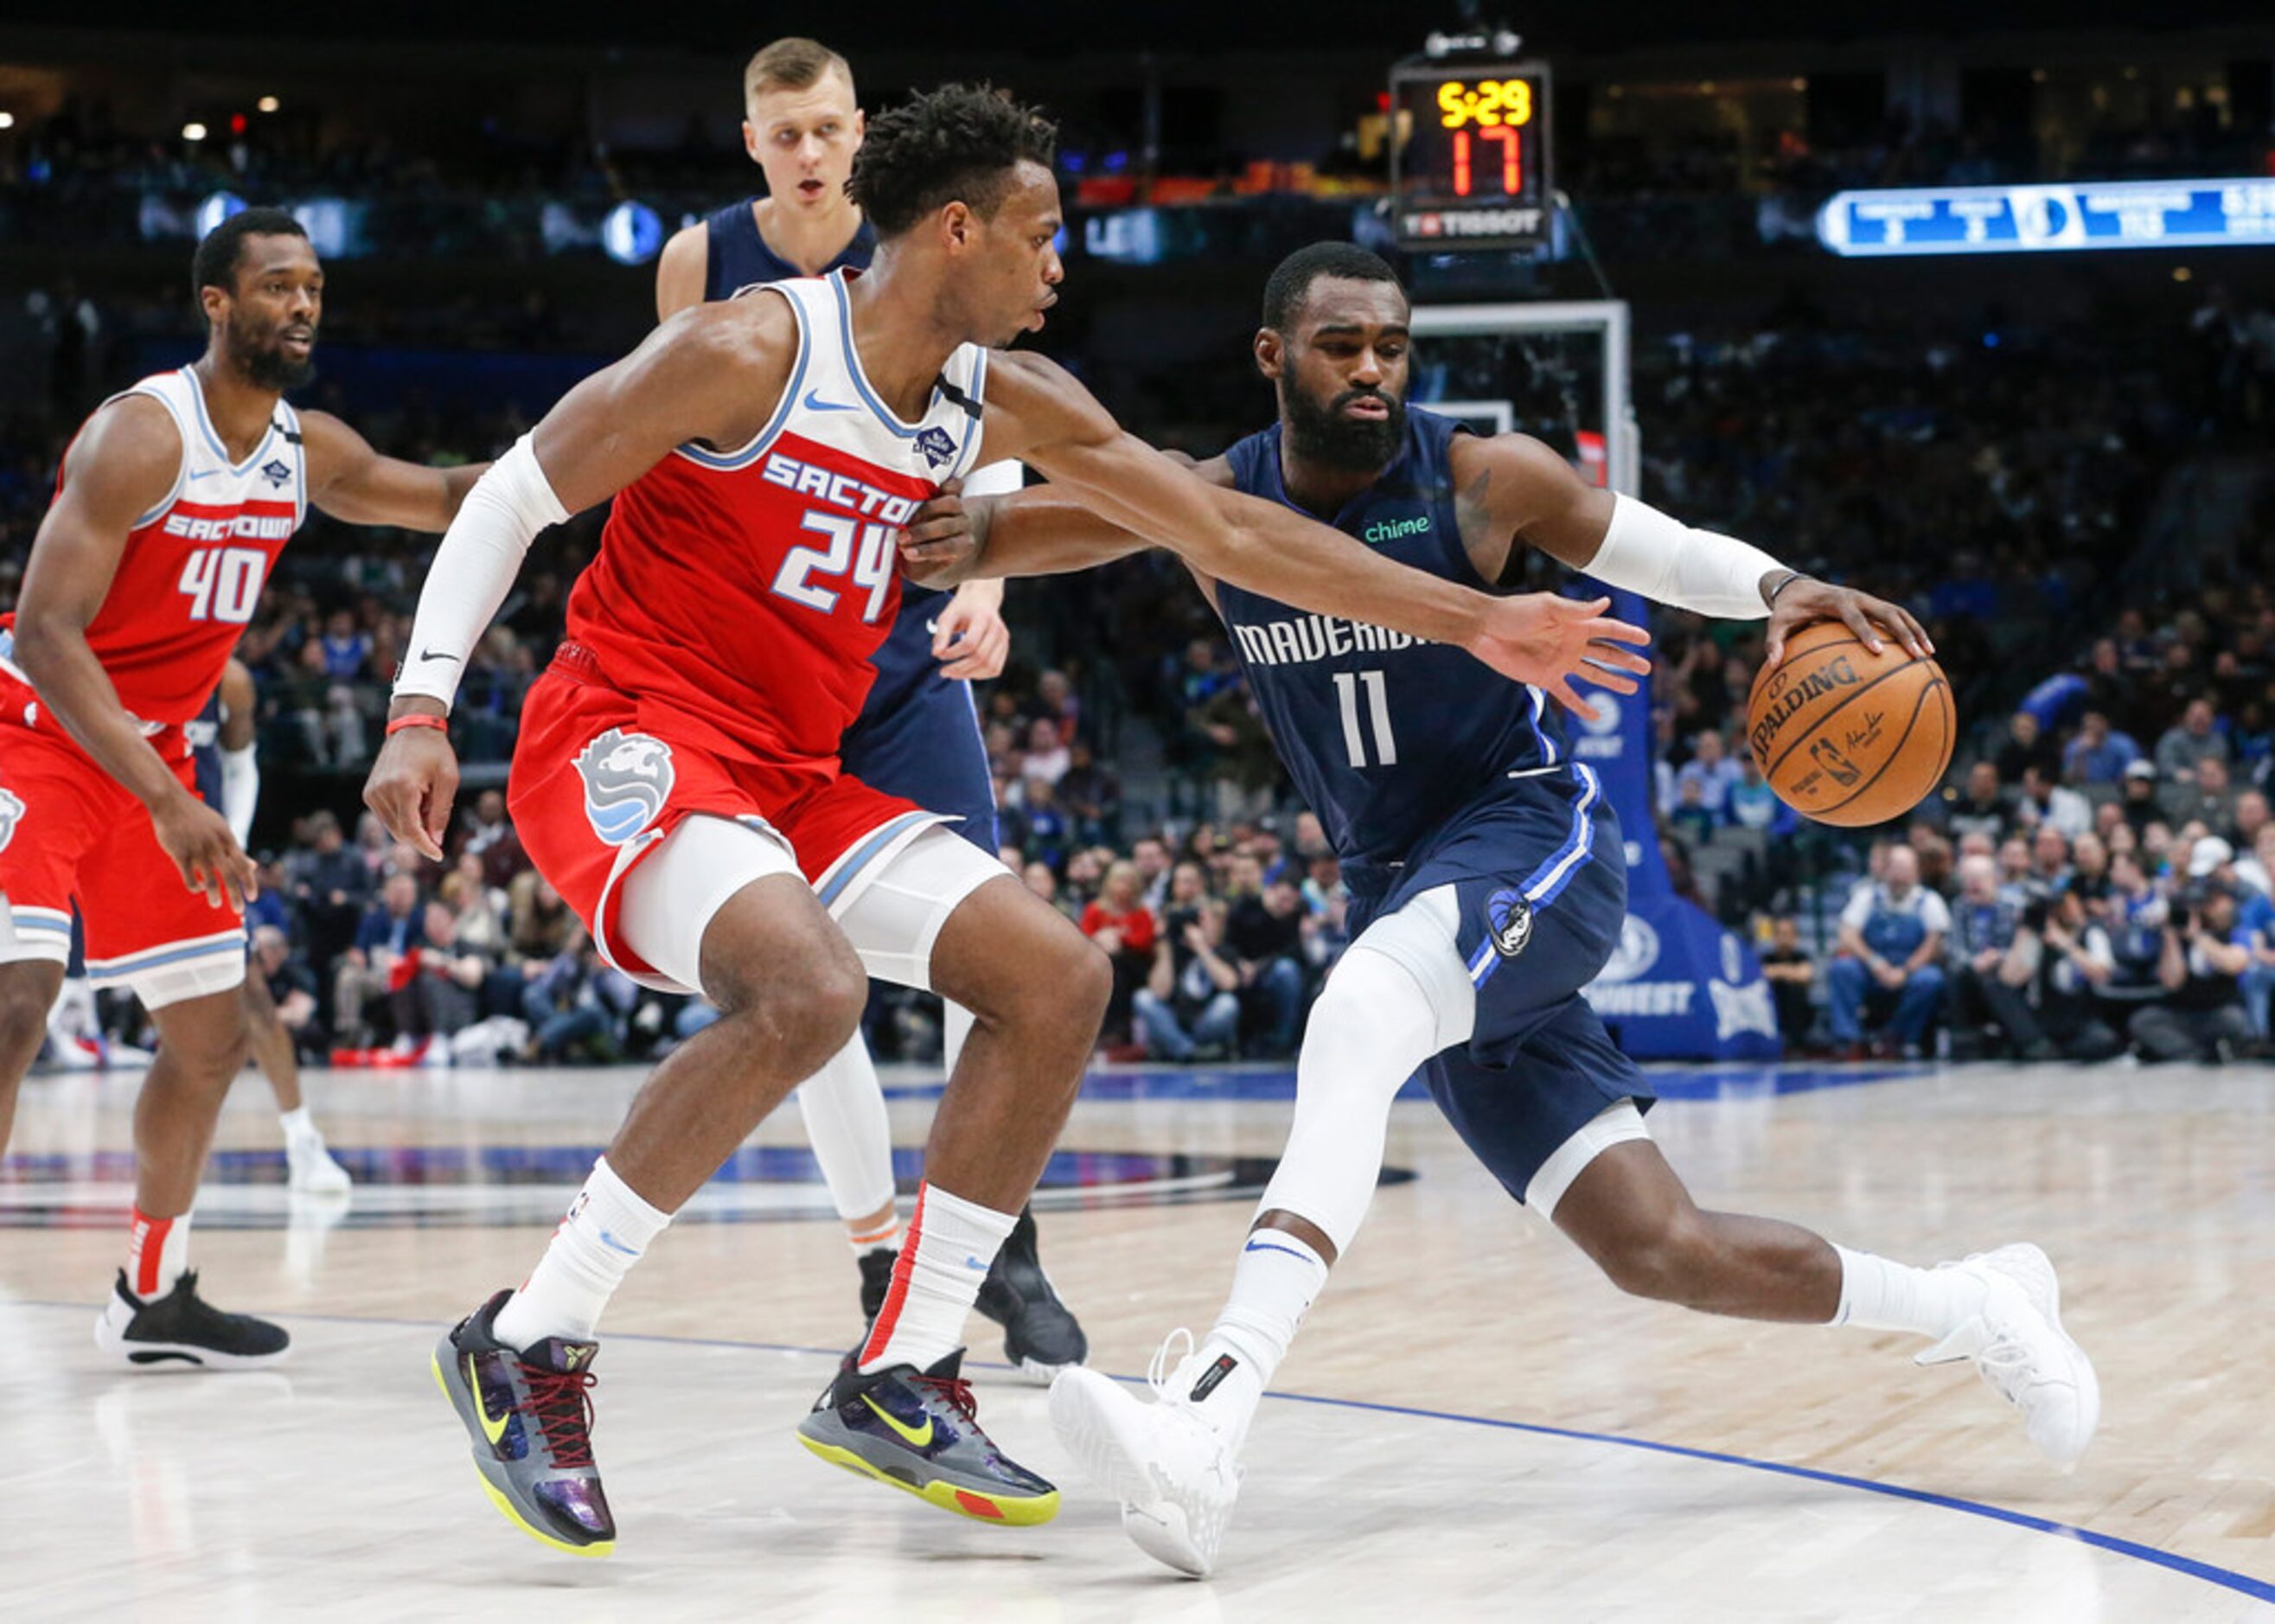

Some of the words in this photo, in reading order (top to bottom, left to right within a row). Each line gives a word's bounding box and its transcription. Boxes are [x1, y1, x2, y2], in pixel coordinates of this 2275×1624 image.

[1437, 80, 1531, 128] 5:29
[1453, 125, 1521, 196] 17
[1441, 209, 1542, 236] TISSOT
[761, 451, 924, 525] SACTO
[770, 508, 899, 623] 24
[1365, 516, 1430, 542] chime
[178, 547, 267, 623] 40
[1332, 669, 1396, 767] 11
[1751, 655, 1859, 764] SPALDING
